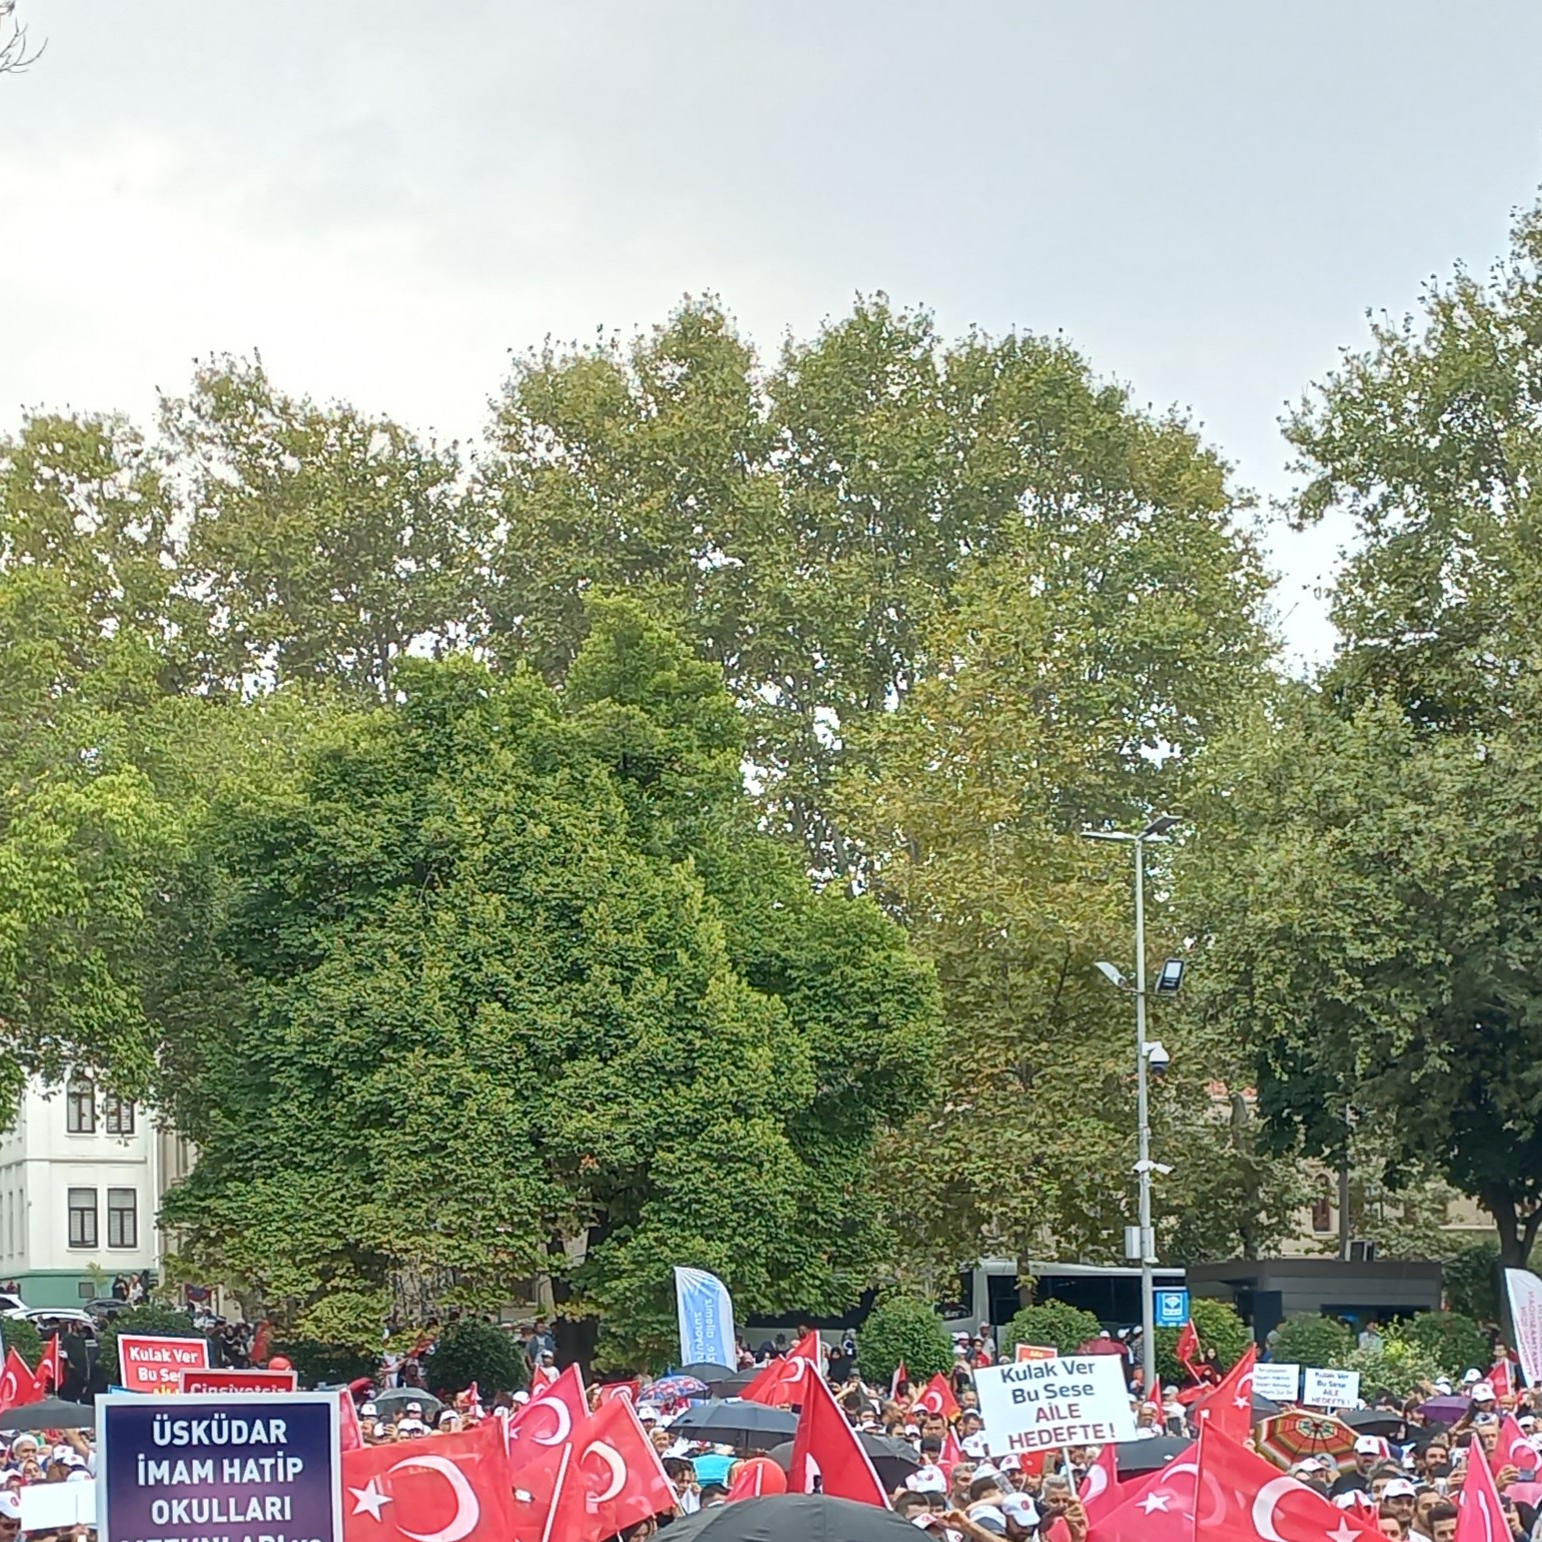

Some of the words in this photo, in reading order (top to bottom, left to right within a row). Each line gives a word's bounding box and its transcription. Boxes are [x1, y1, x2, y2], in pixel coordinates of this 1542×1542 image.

[130, 1346, 171, 1363] Kulak
[173, 1349, 199, 1364] Ver
[138, 1367, 157, 1382] Bu
[1000, 1362, 1058, 1383] Kulak
[1061, 1360, 1095, 1376] Ver
[1011, 1388, 1039, 1404] Bu
[1043, 1384, 1095, 1399] Sese
[1035, 1402, 1082, 1423] AİLE
[152, 1413, 287, 1446] ÜSKÜDAR
[1008, 1424, 1106, 1450] HEDEFTE
[137, 1453, 214, 1486] İMAM
[222, 1451, 304, 1483] HATİP
[151, 1496, 292, 1525] OKULLARI
